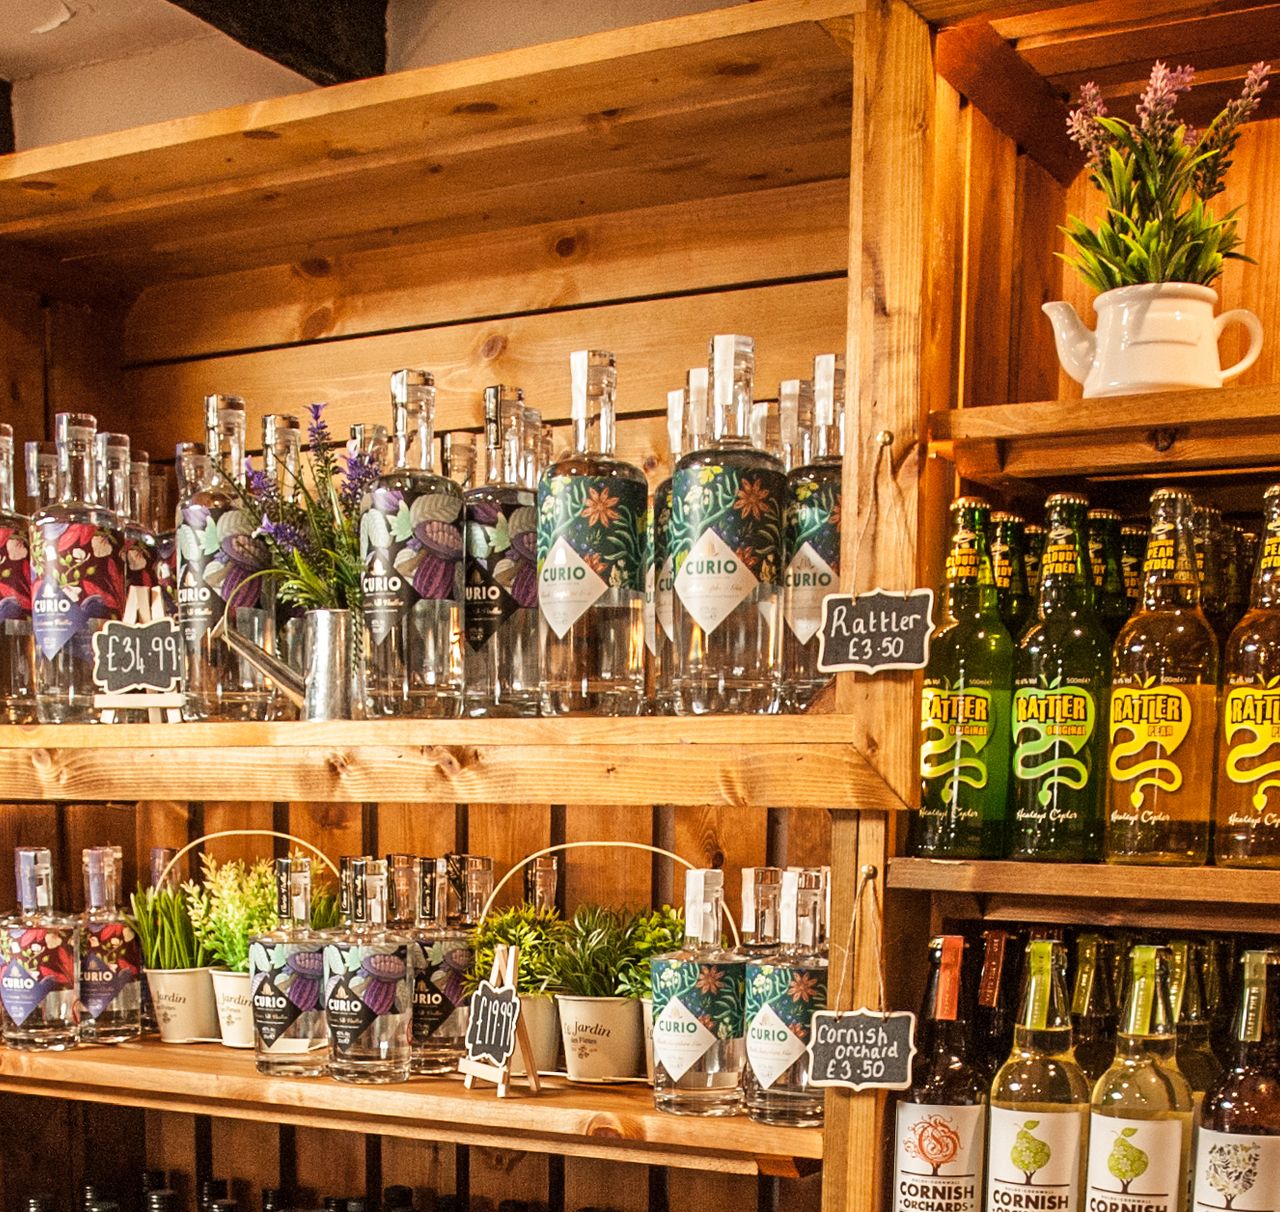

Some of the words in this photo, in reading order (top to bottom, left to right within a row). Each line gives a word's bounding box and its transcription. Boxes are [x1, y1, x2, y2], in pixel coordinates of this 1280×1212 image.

[1042, 552, 1078, 564] CLOUDY
[543, 566, 586, 582] CURIO
[686, 560, 738, 576] CURIO
[1043, 563, 1076, 574] CYDER
[363, 576, 401, 593] CURIO
[785, 573, 832, 587] CURIO
[34, 599, 71, 613] CURIO
[831, 606, 921, 638] Rattler
[106, 633, 178, 673] £34.99
[848, 637, 903, 661] £3.50
[922, 694, 988, 721] RATTLER
[1016, 694, 1087, 722] RATTLER
[1114, 694, 1182, 722] RATTLER
[1046, 726, 1086, 736] ORIGINAL
[1148, 726, 1173, 736] PEAR
[2, 978, 33, 990] CURIO
[253, 996, 287, 1009] CURIO
[328, 999, 362, 1013] CURIO
[476, 996, 515, 1046] £19.99
[658, 1021, 698, 1034] CURIO
[572, 1022, 611, 1039] Jardin
[750, 1028, 788, 1042] CURIO
[817, 1024, 888, 1044] Cornish
[899, 1182, 974, 1199] CORNISH
[903, 1199, 968, 1212] ORCHARDS
[993, 1191, 1069, 1210] CORNISH
